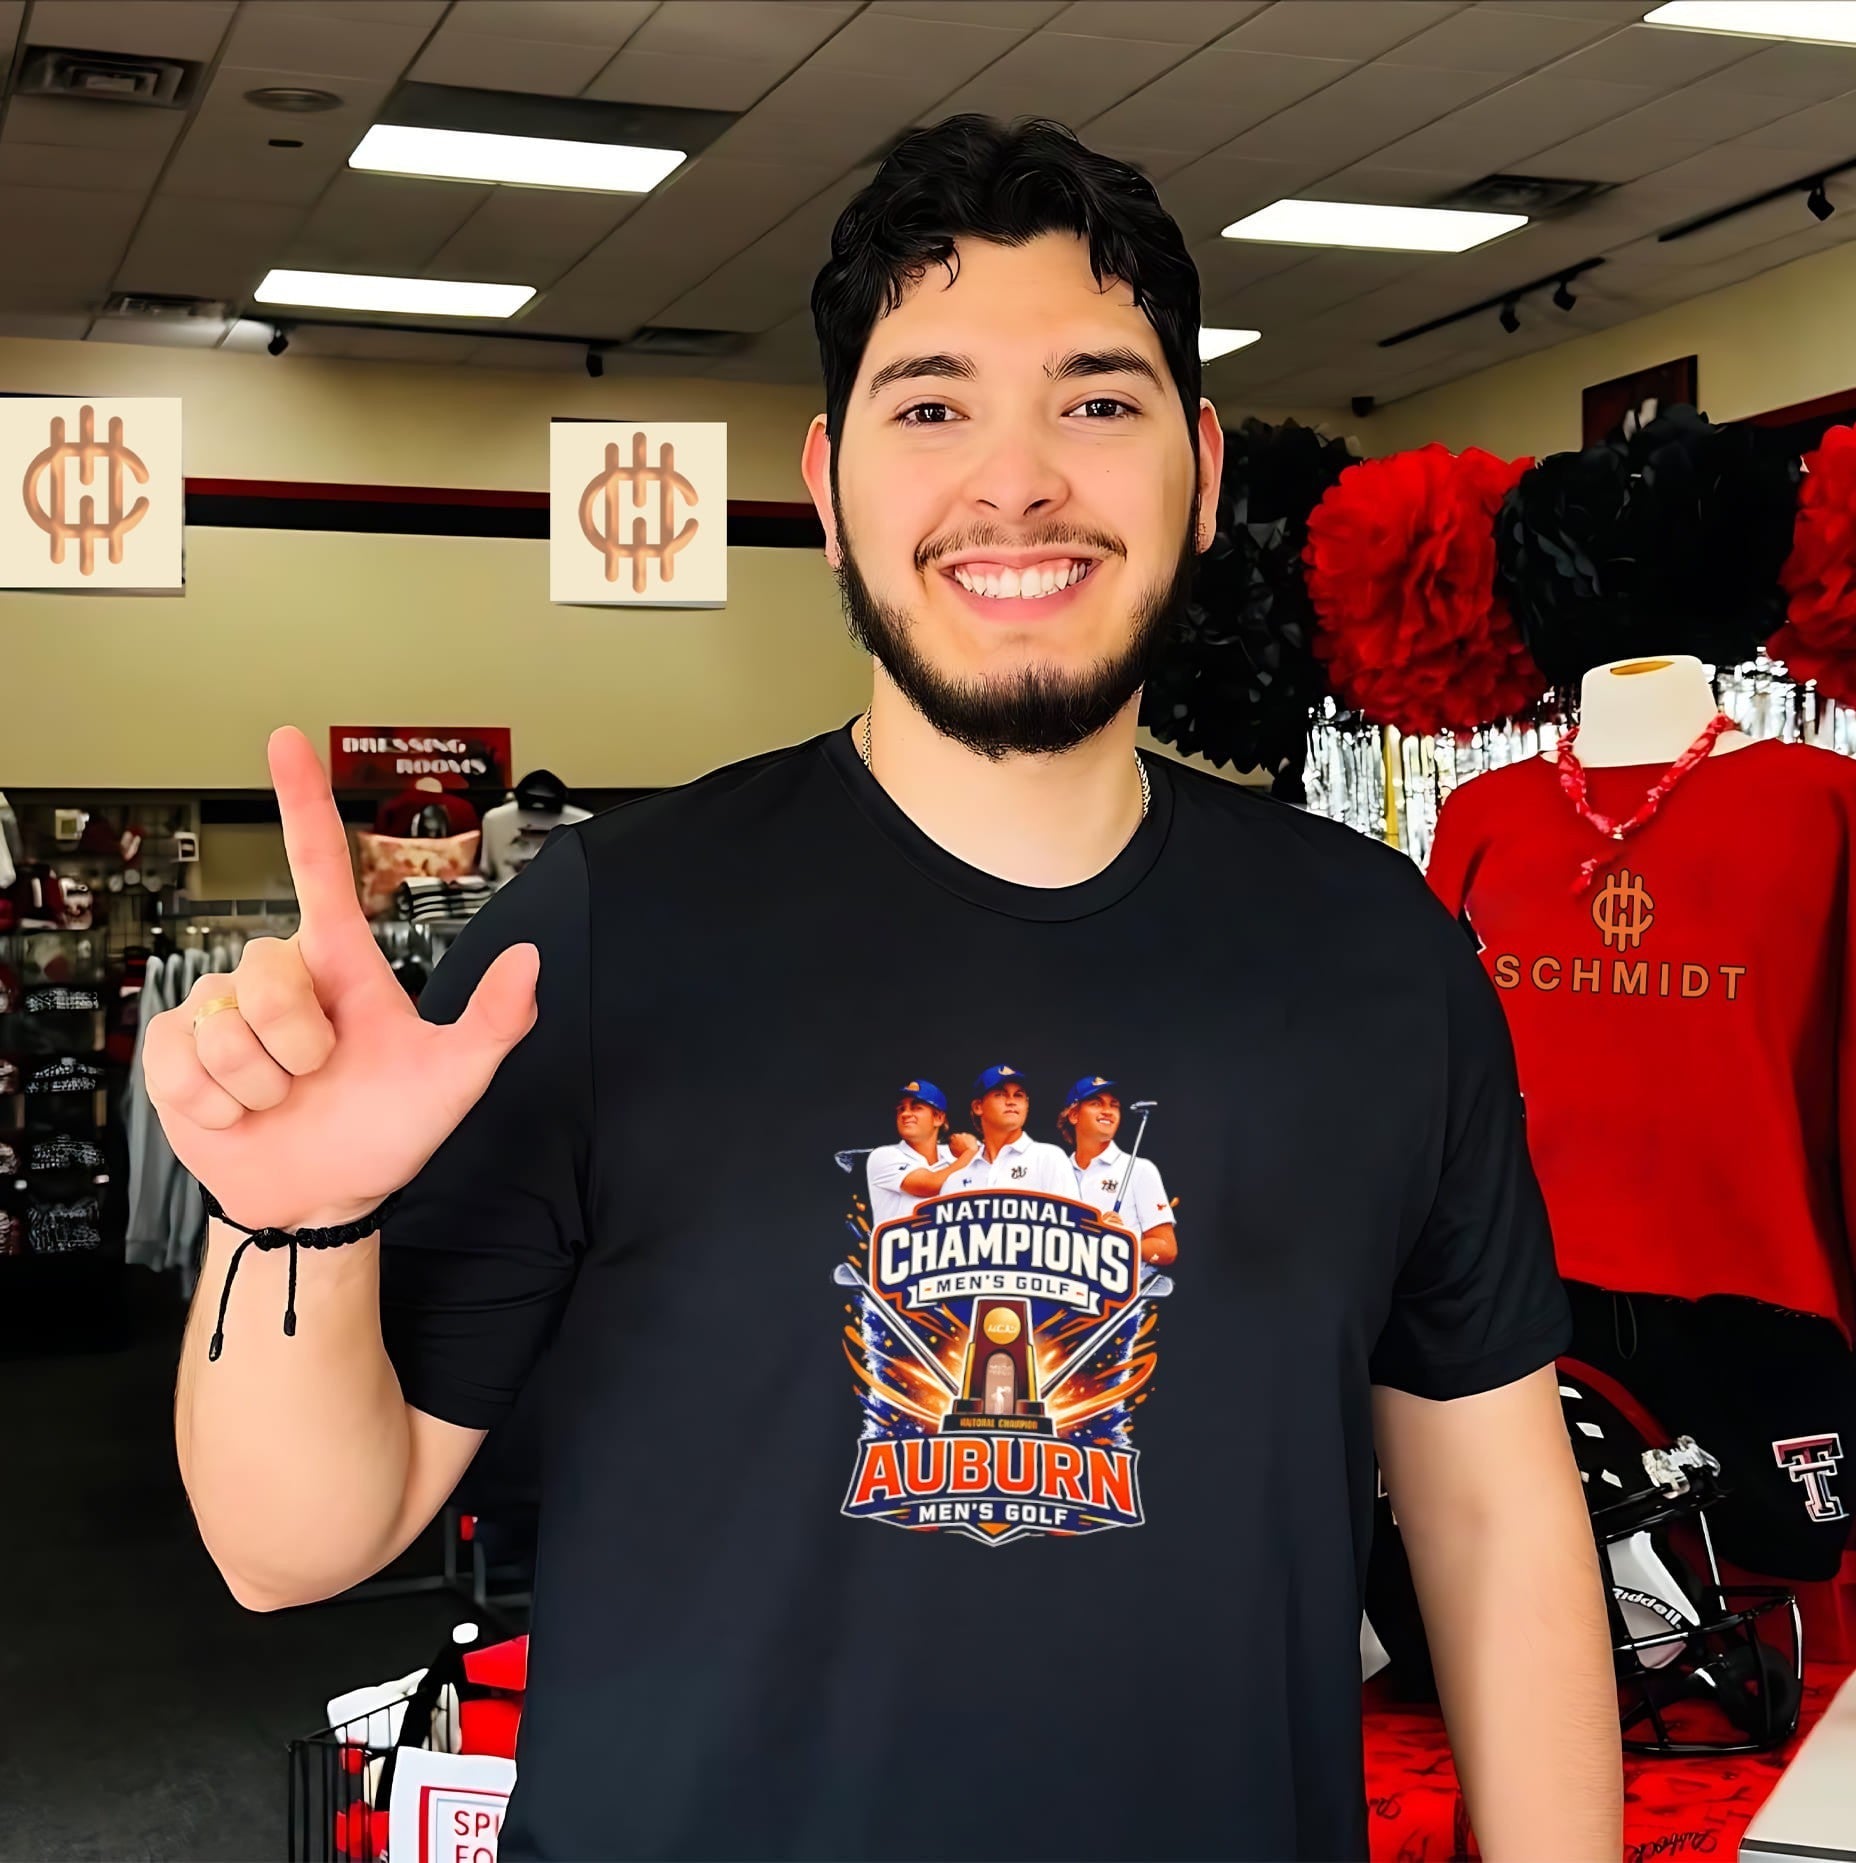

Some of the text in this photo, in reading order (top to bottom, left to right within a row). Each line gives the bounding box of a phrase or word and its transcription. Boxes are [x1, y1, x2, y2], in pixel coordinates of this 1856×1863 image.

[342, 737, 467, 753] DRESSING
[396, 758, 487, 775] ROOMS
[1494, 953, 1747, 1000] SCHMIDT
[935, 1198, 1076, 1228] NATIONAL
[880, 1222, 1130, 1294] CHAMPIONS
[935, 1273, 1072, 1296] MEN'S GOLF
[850, 1438, 1136, 1516] AUBURN
[918, 1503, 1069, 1525] MEN'S GOLF
